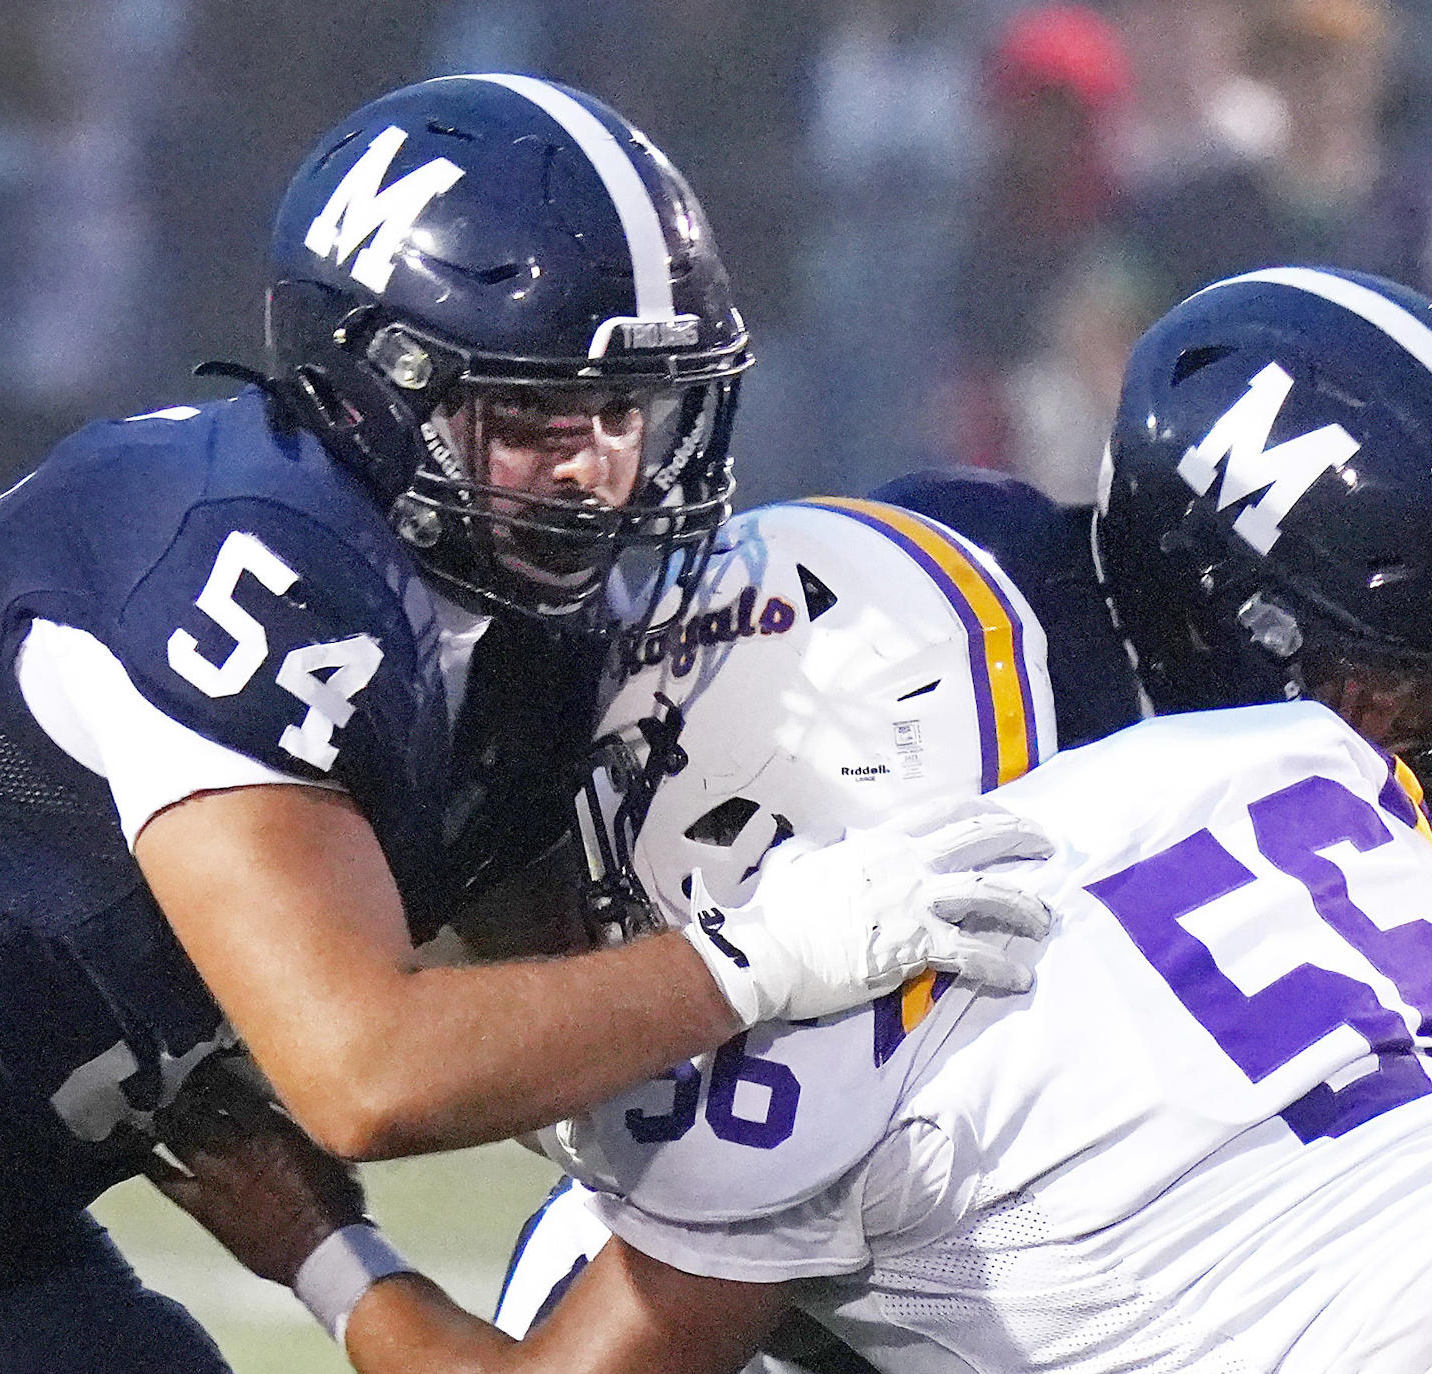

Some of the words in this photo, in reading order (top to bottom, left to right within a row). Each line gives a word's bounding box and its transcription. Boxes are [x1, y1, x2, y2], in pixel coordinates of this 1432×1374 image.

[305, 125, 465, 294] M
[1177, 362, 1360, 556] M
[168, 531, 385, 771] 54
[841, 765, 888, 776] Riddell
